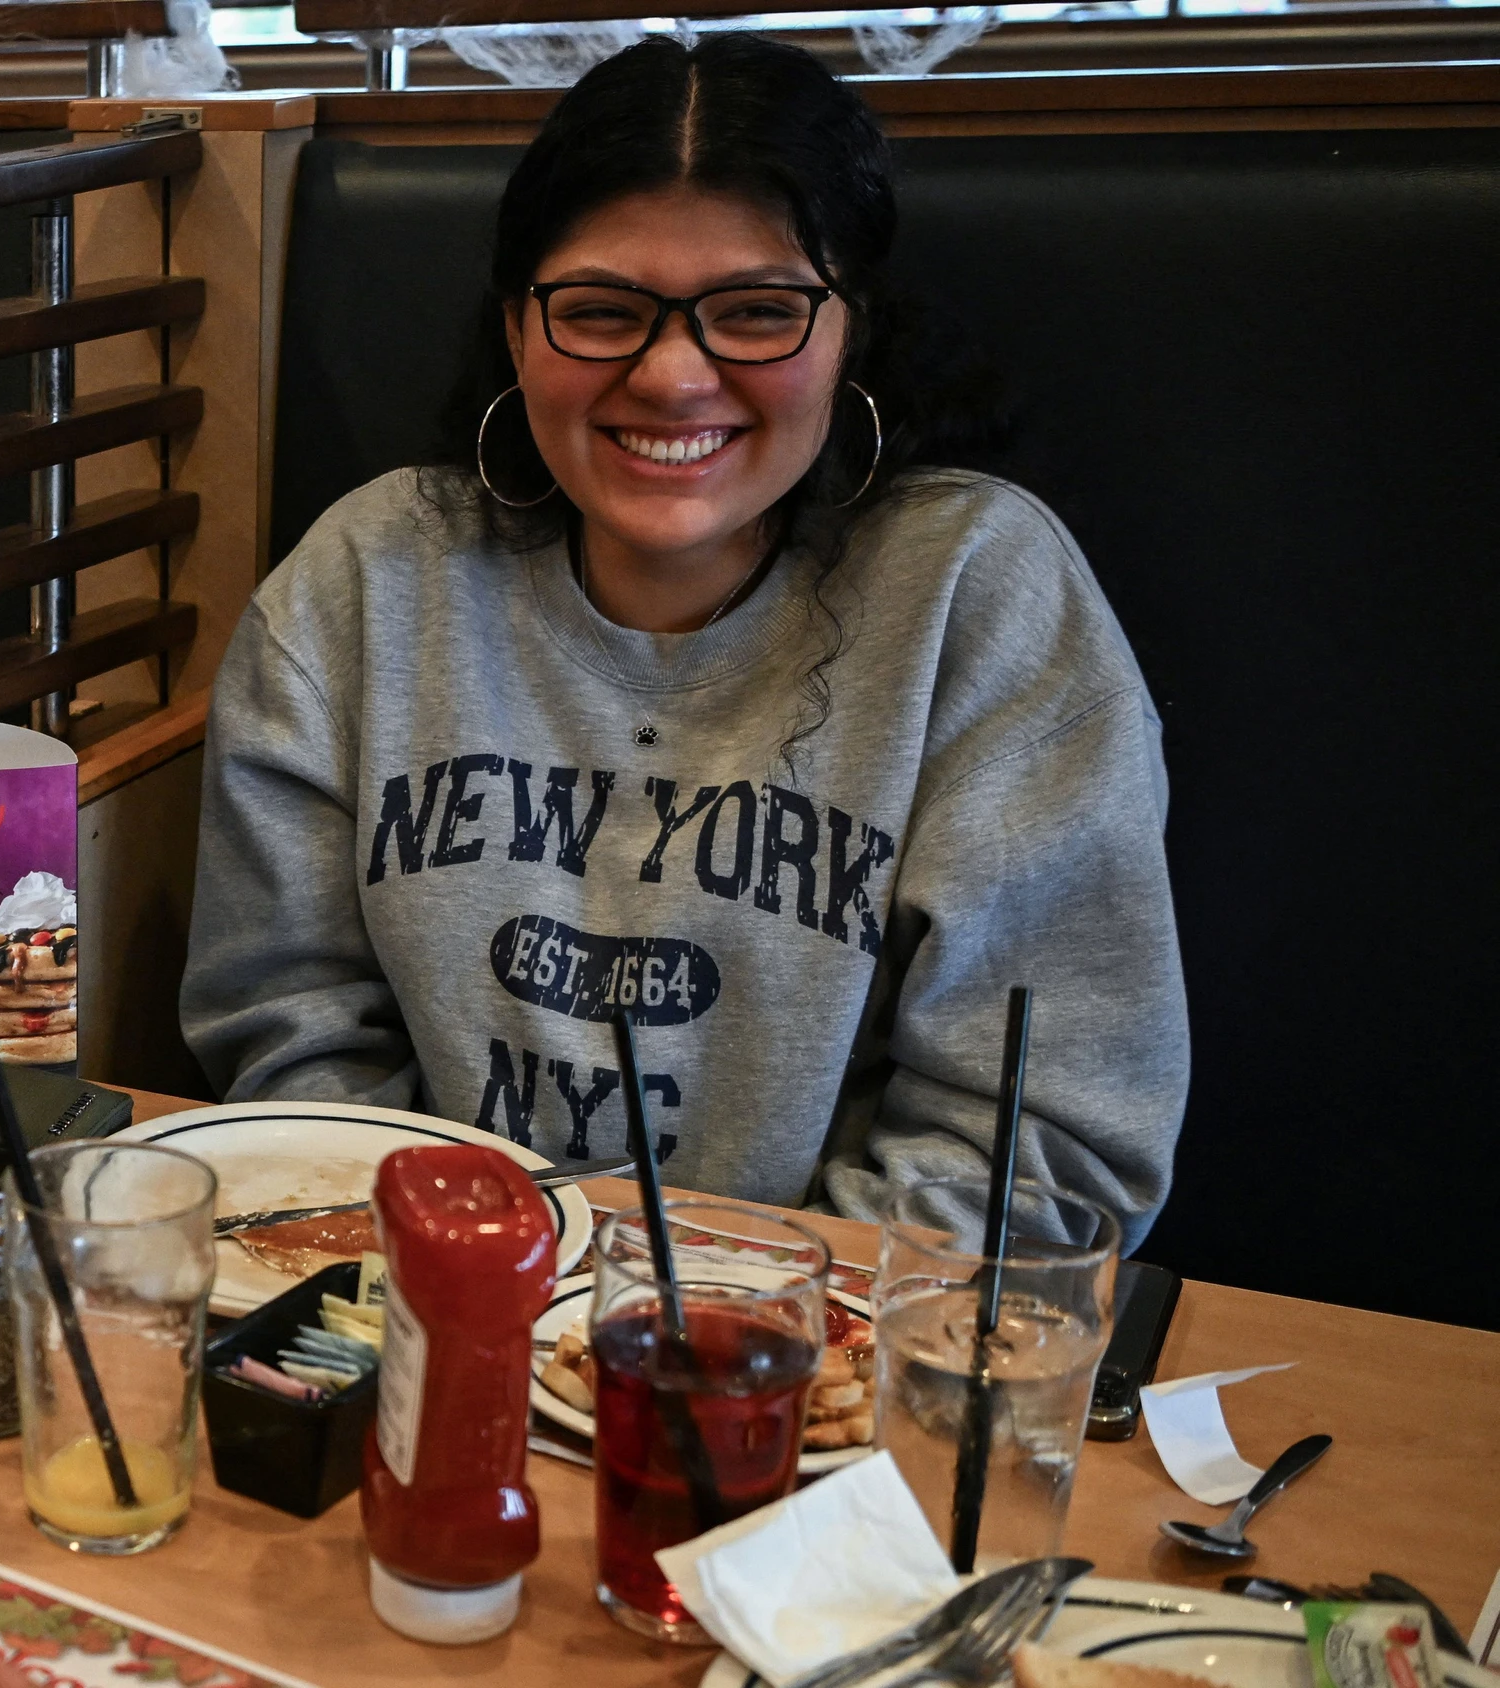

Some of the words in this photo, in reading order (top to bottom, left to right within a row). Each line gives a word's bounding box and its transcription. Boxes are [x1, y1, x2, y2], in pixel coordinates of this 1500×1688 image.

[366, 753, 616, 887] NEW
[639, 775, 896, 959] YORK
[506, 928, 589, 1001] EST.
[604, 952, 697, 1009] 1664
[474, 1038, 681, 1165] NYC
